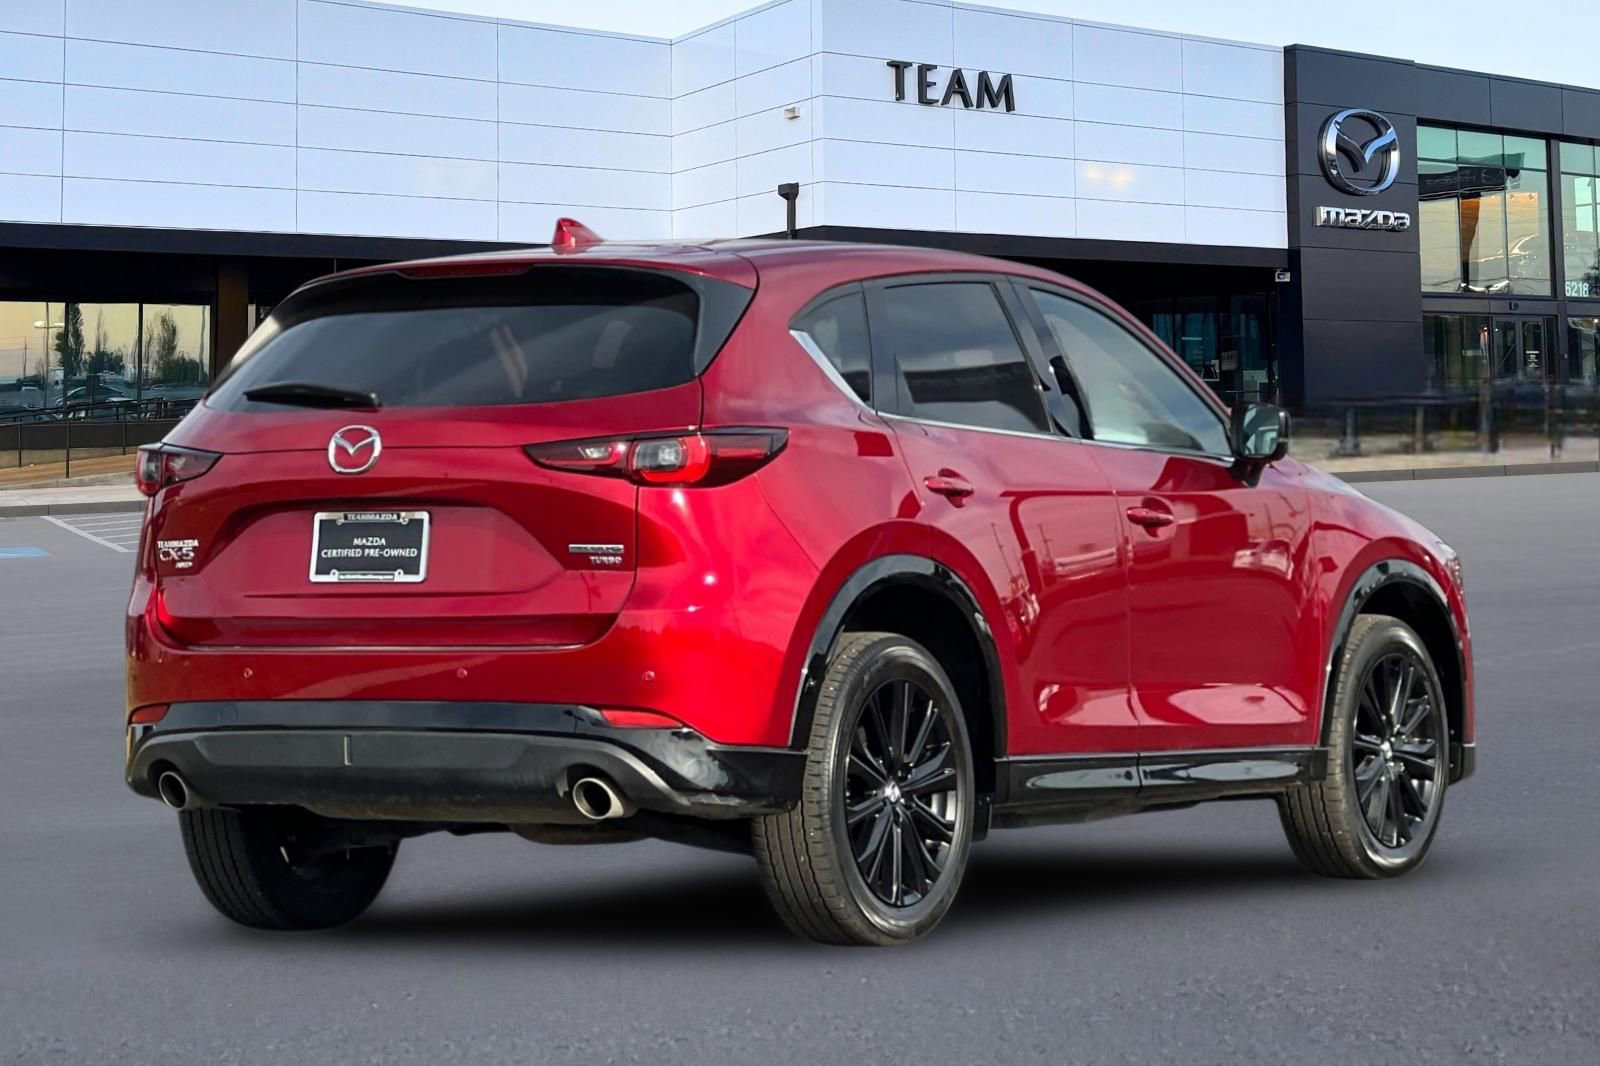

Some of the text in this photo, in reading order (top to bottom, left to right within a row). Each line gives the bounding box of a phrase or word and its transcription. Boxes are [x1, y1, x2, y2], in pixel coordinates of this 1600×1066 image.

[887, 60, 1015, 112] TEAM
[1565, 281, 1590, 297] 6218
[352, 537, 386, 546] MAZDA
[160, 547, 195, 561] CX-5
[321, 548, 418, 558] CERTIFIED PRE-OWNED
[589, 556, 622, 564] TURBO
